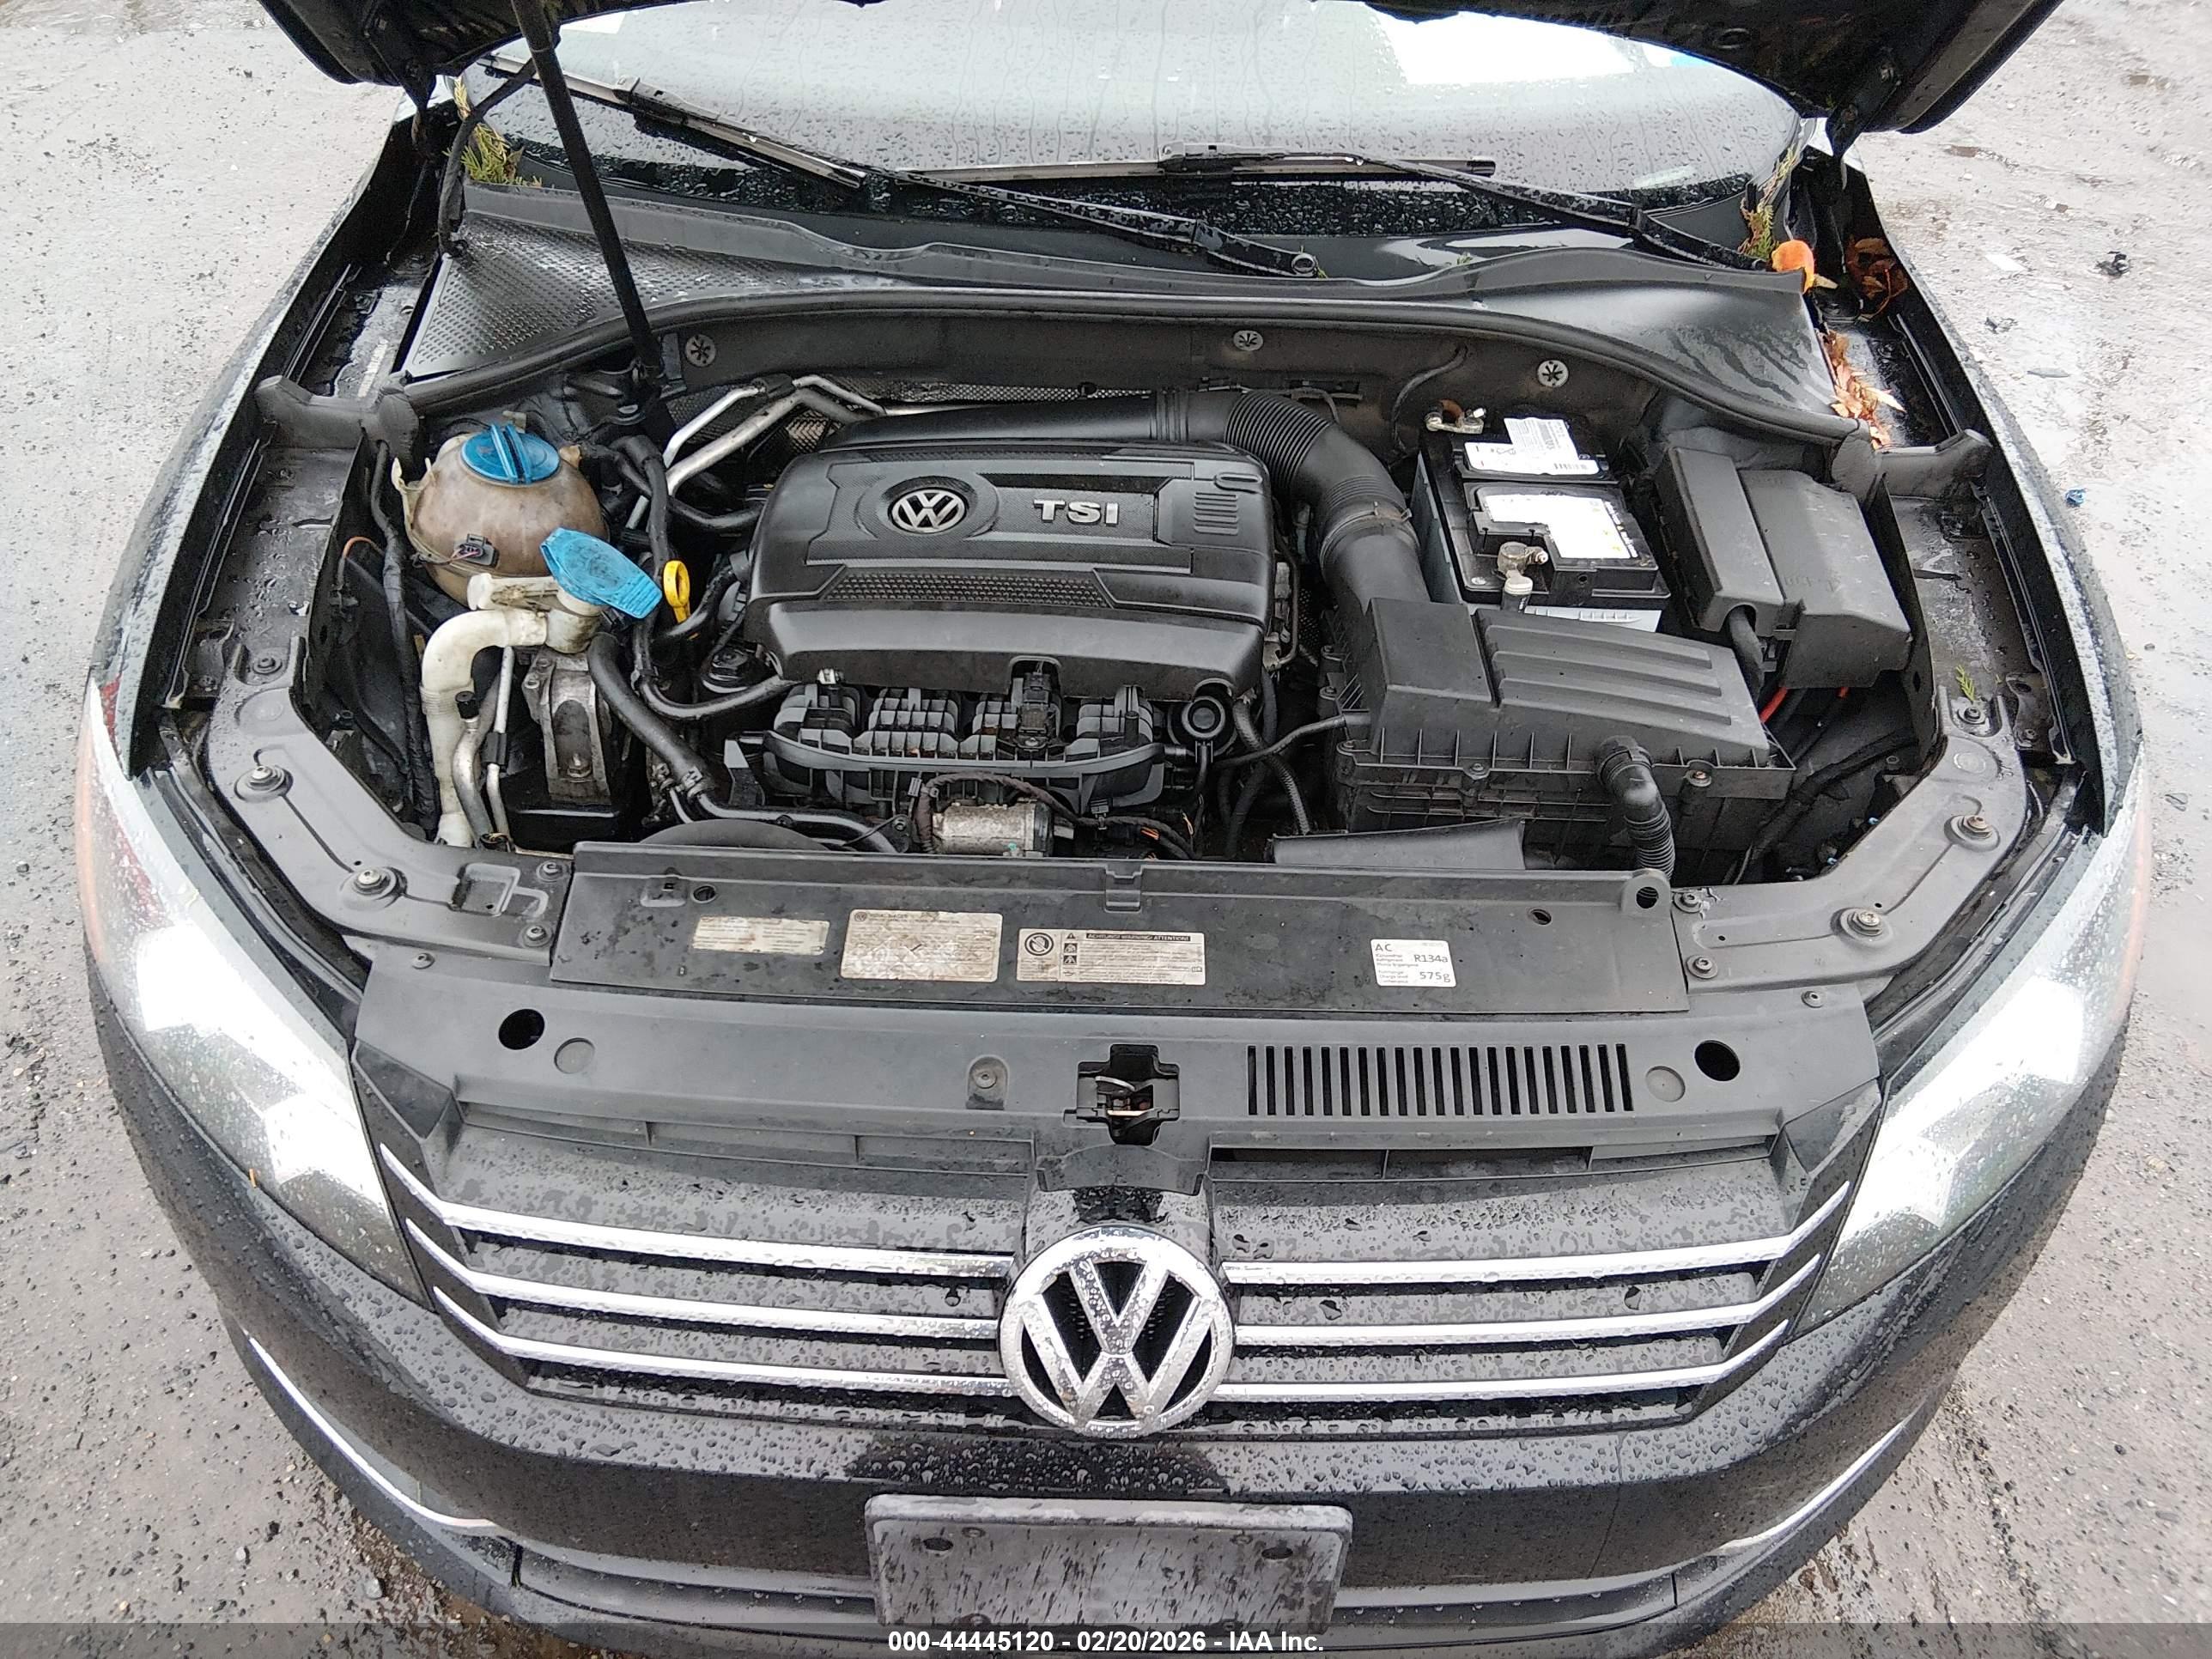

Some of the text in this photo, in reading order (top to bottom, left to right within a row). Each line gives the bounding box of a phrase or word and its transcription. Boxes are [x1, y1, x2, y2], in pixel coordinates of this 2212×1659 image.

[890, 487, 965, 534] VW
[1034, 499, 1119, 526] TSI
[1413, 954, 1449, 963] R134a
[999, 1224, 1234, 1439] VW
